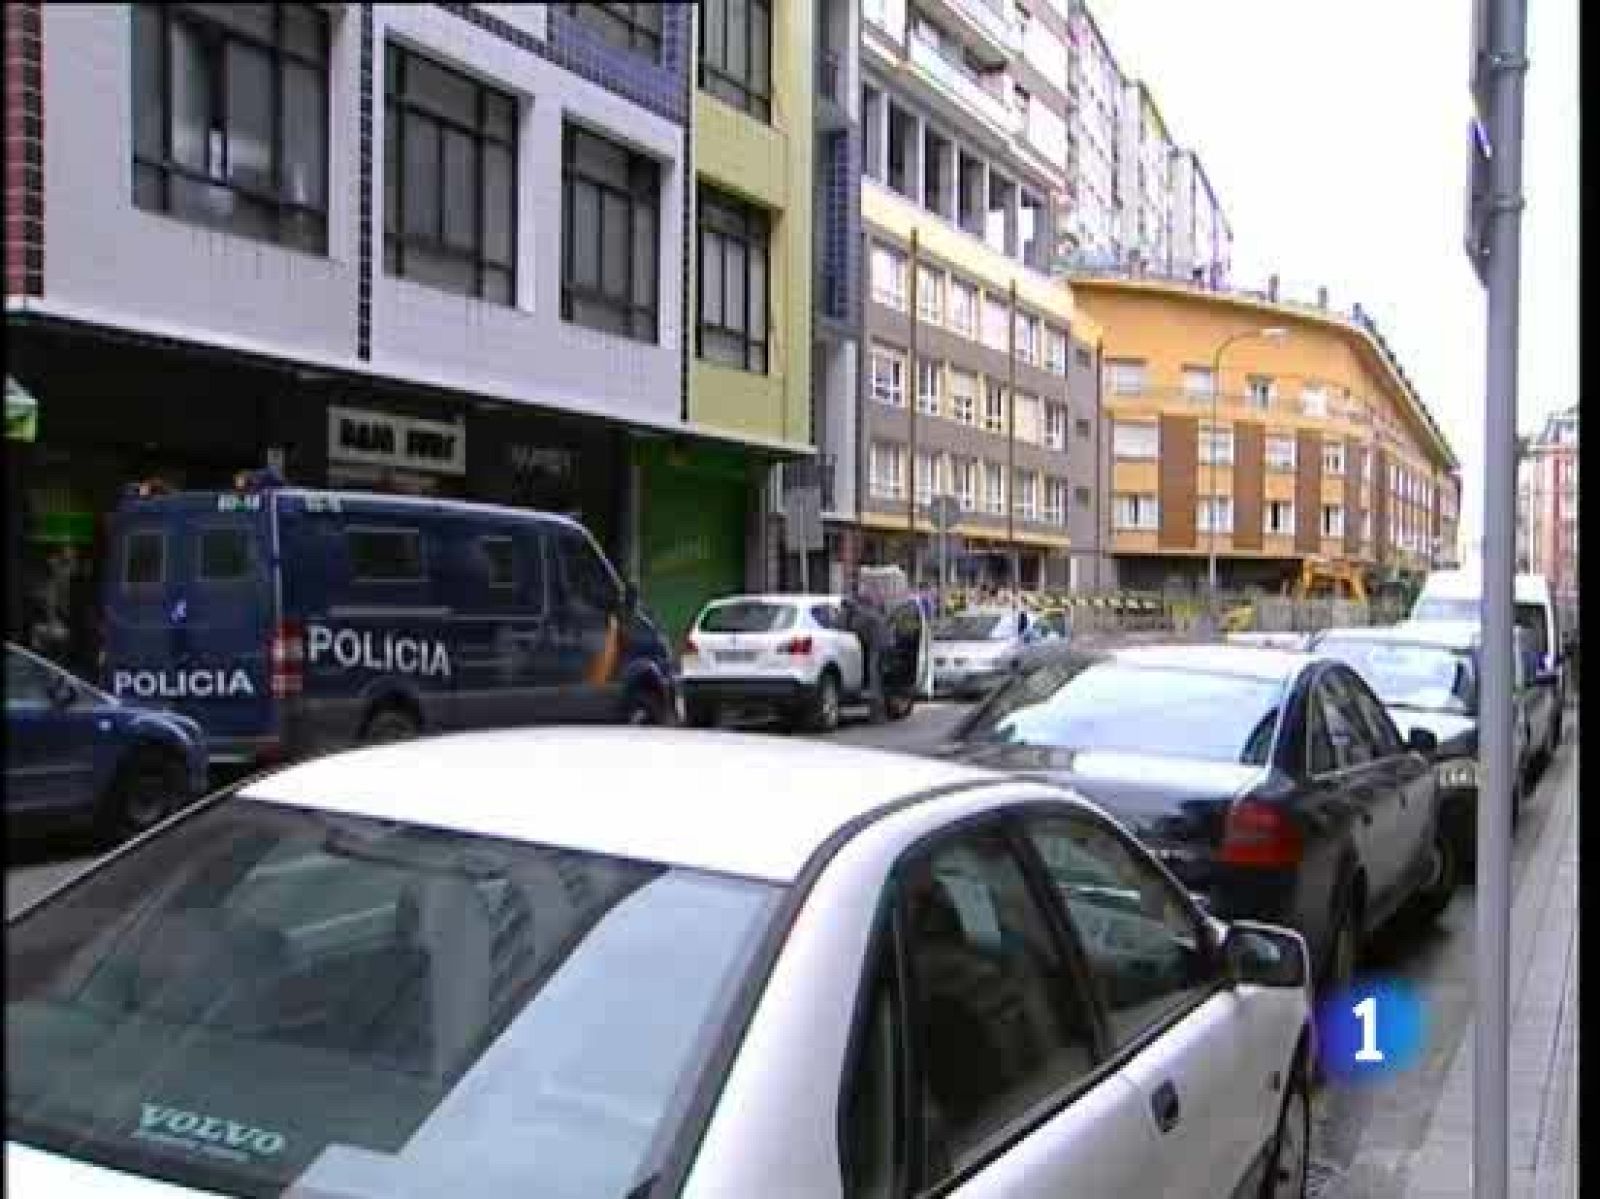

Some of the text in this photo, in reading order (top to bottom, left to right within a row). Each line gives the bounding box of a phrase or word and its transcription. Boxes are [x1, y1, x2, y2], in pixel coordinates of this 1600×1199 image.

[309, 625, 450, 676] POLICIA
[113, 670, 254, 697] POLICIA
[140, 1102, 284, 1153] VOLVO
